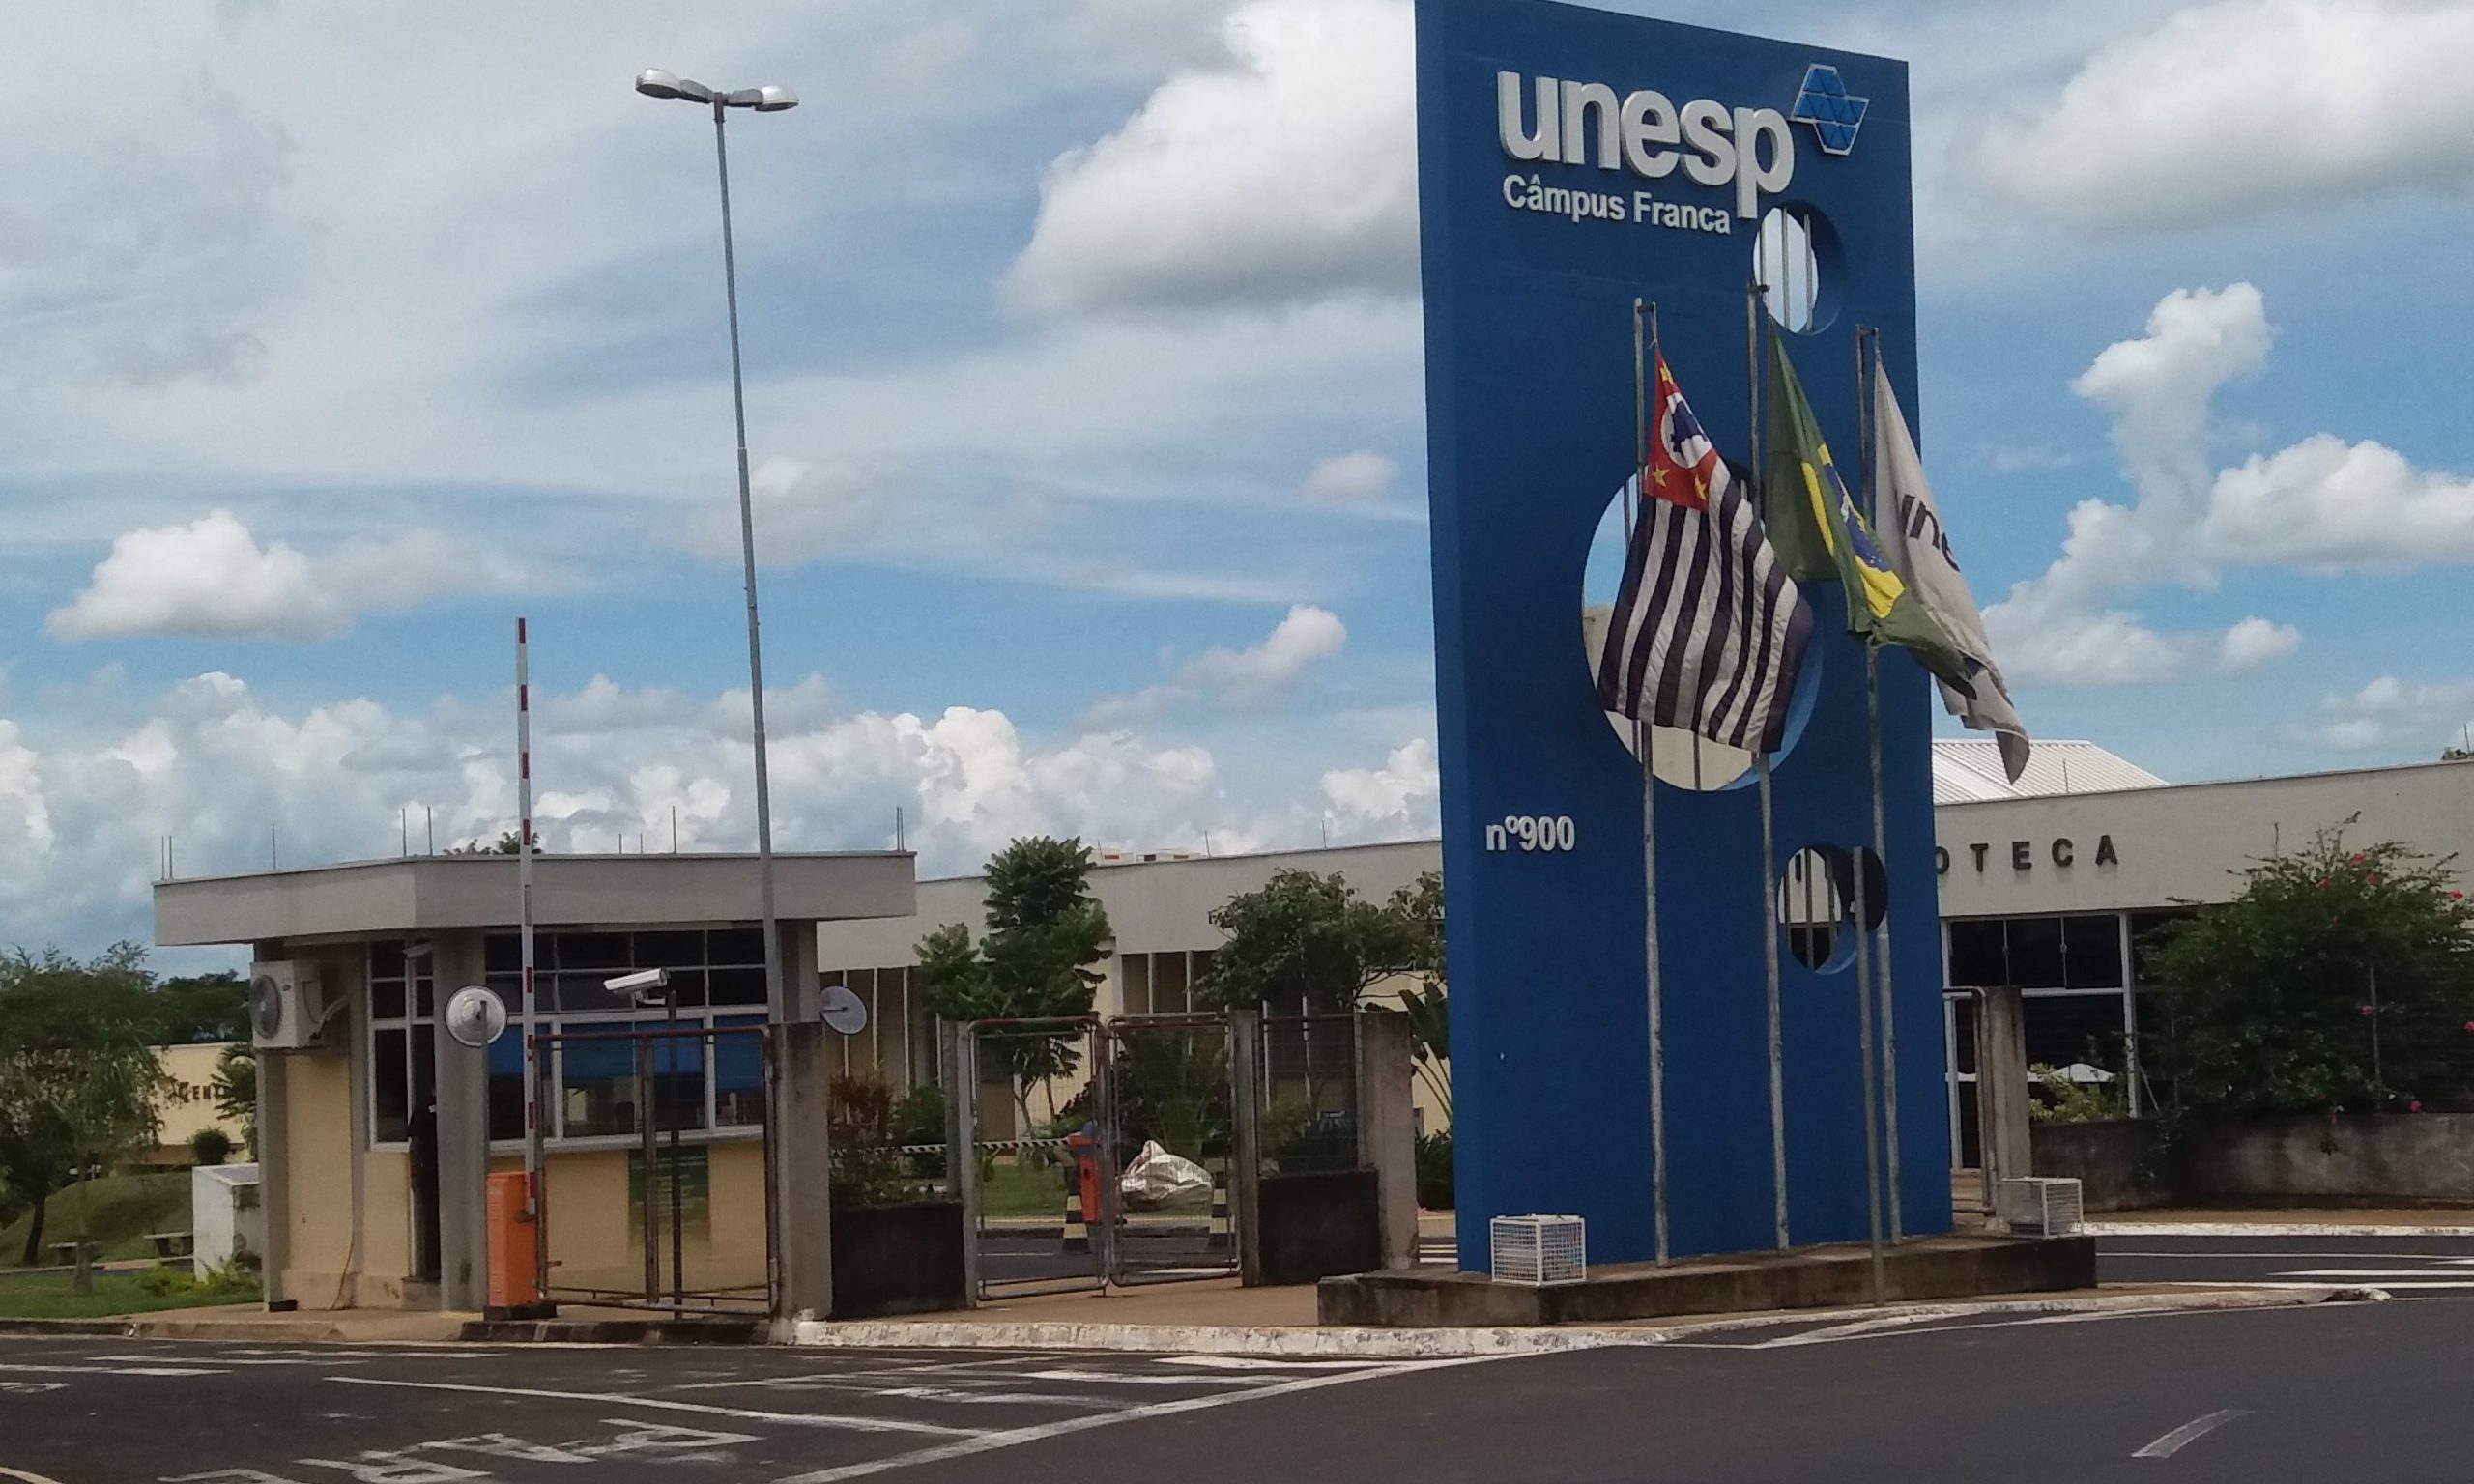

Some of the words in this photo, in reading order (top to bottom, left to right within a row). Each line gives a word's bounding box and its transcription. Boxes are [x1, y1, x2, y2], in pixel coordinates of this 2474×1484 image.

[1497, 71, 1795, 219] unesp
[1503, 174, 1625, 222] Câmpus
[1633, 191, 1731, 235] Franca
